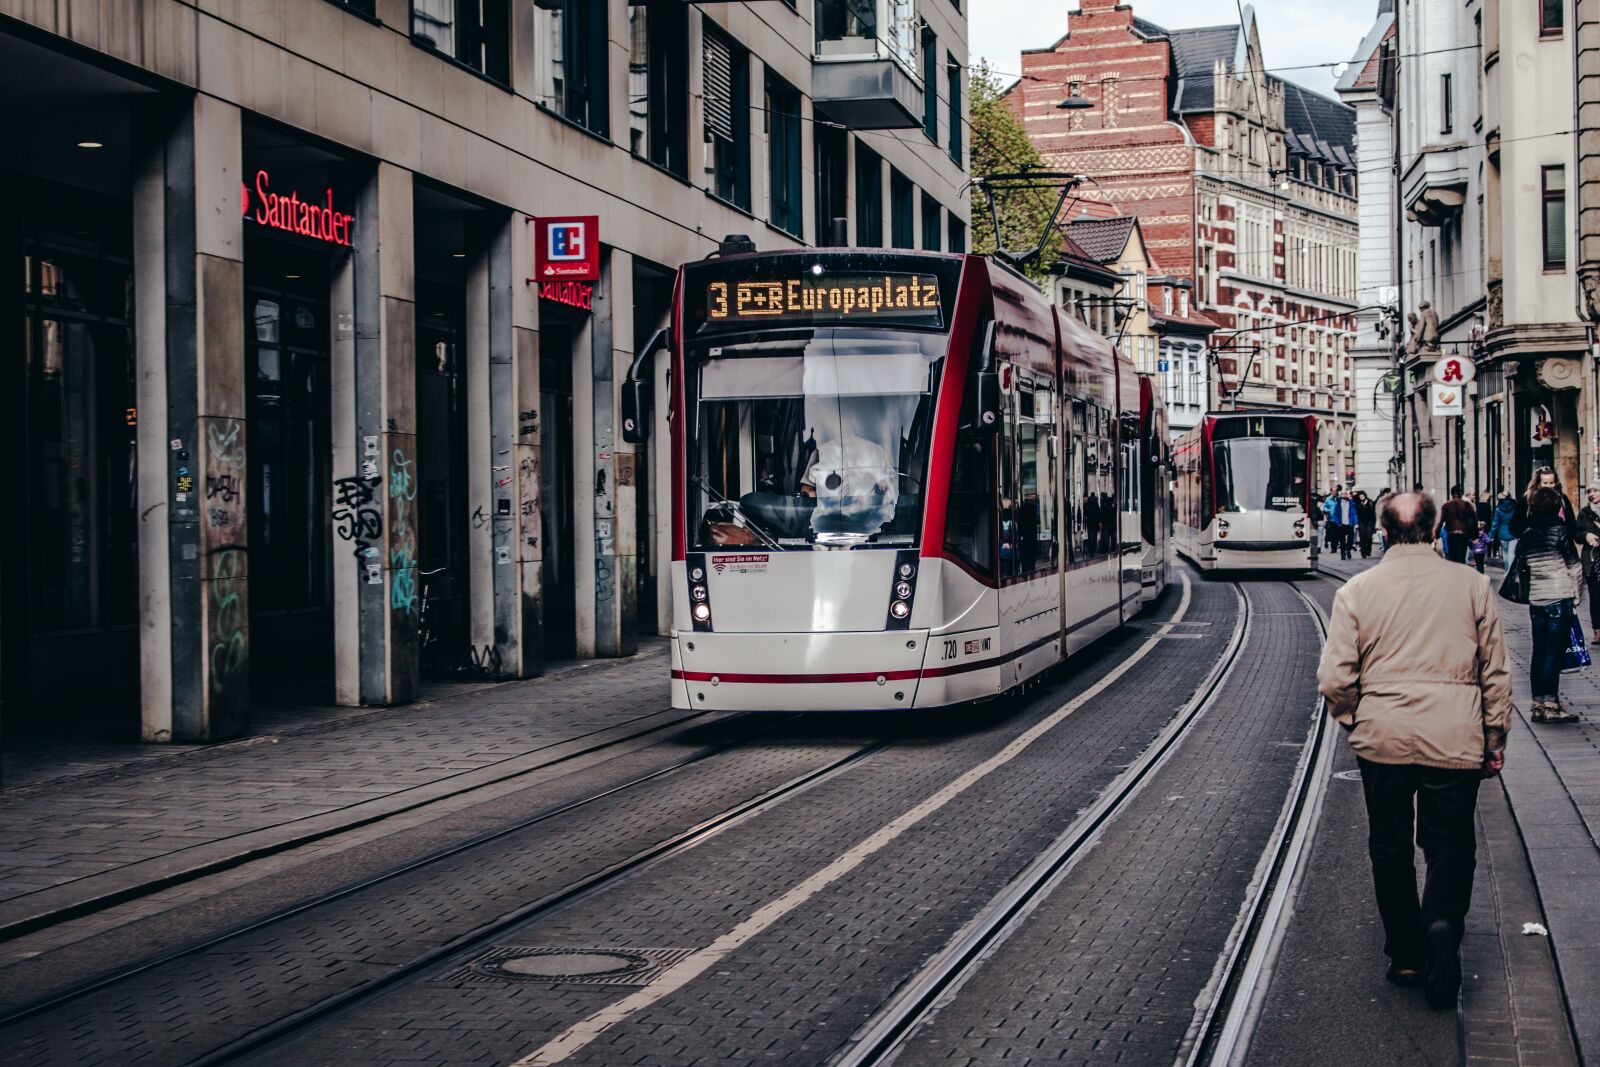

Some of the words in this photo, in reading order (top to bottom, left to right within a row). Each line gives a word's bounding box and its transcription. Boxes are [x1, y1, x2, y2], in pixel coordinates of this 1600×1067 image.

[255, 169, 353, 246] Santander
[556, 267, 589, 275] Santander
[711, 282, 728, 318] 3
[737, 286, 783, 312] P+R
[787, 276, 937, 314] Europaplatz
